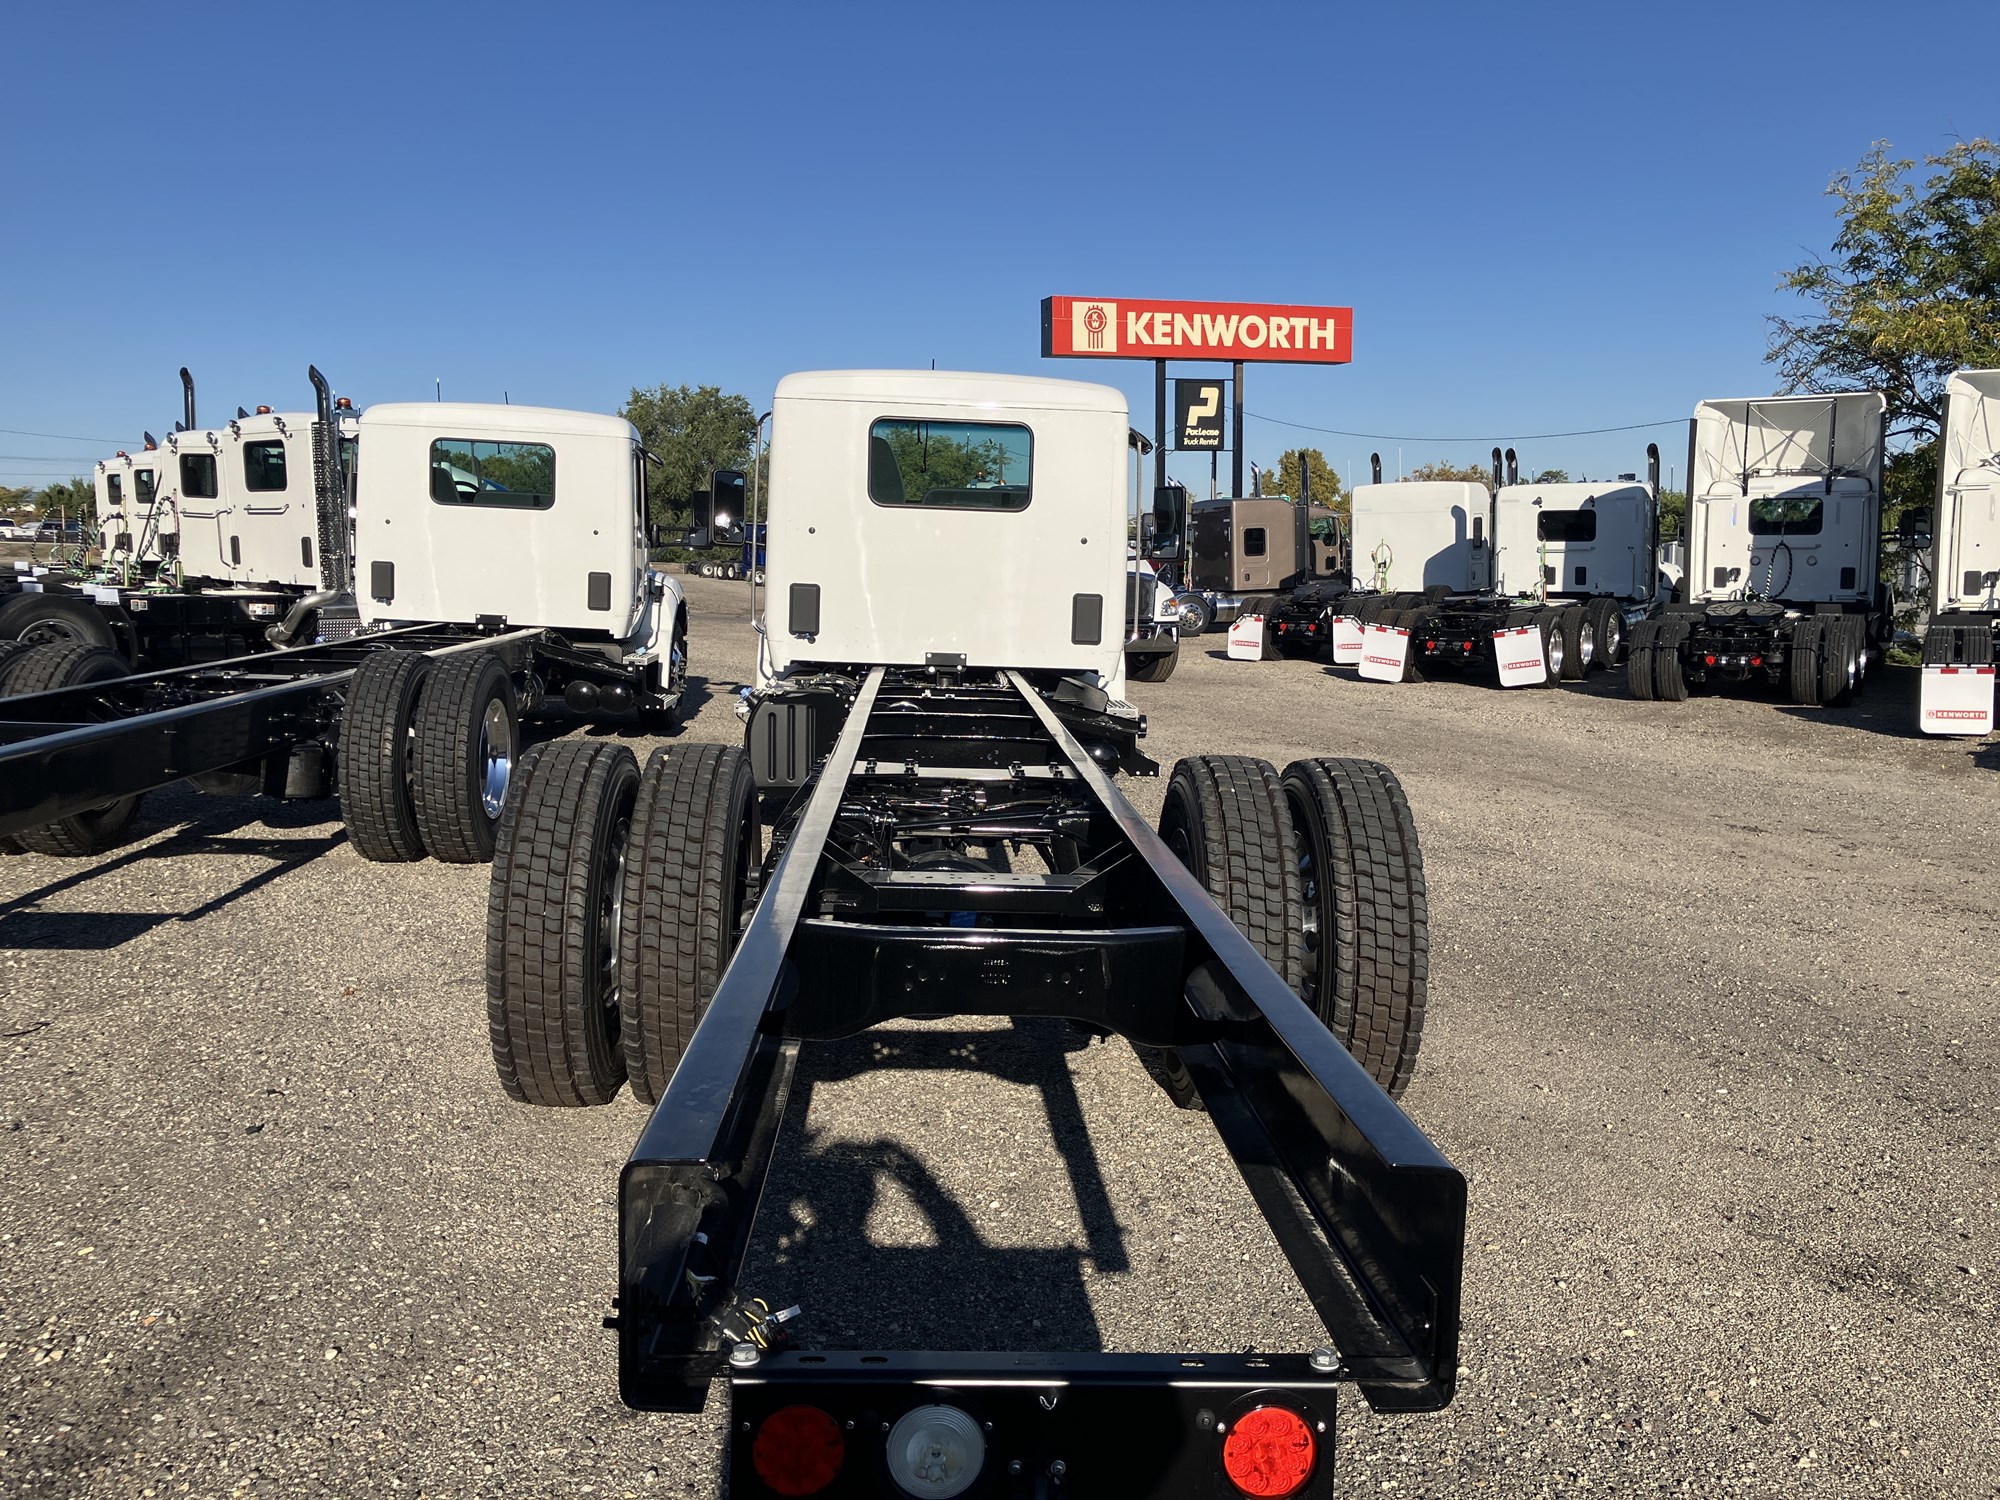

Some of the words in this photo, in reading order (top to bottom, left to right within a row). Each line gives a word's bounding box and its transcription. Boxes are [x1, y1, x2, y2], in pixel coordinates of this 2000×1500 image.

[1127, 312, 1334, 350] KENWORTH
[1185, 427, 1220, 436] PacLease
[1183, 437, 1199, 445] Truck
[1199, 437, 1219, 445] Rental
[1370, 656, 1400, 666] KENWORTH
[1508, 660, 1540, 669] KENWORTH
[1937, 711, 1986, 719] KENWORTH
